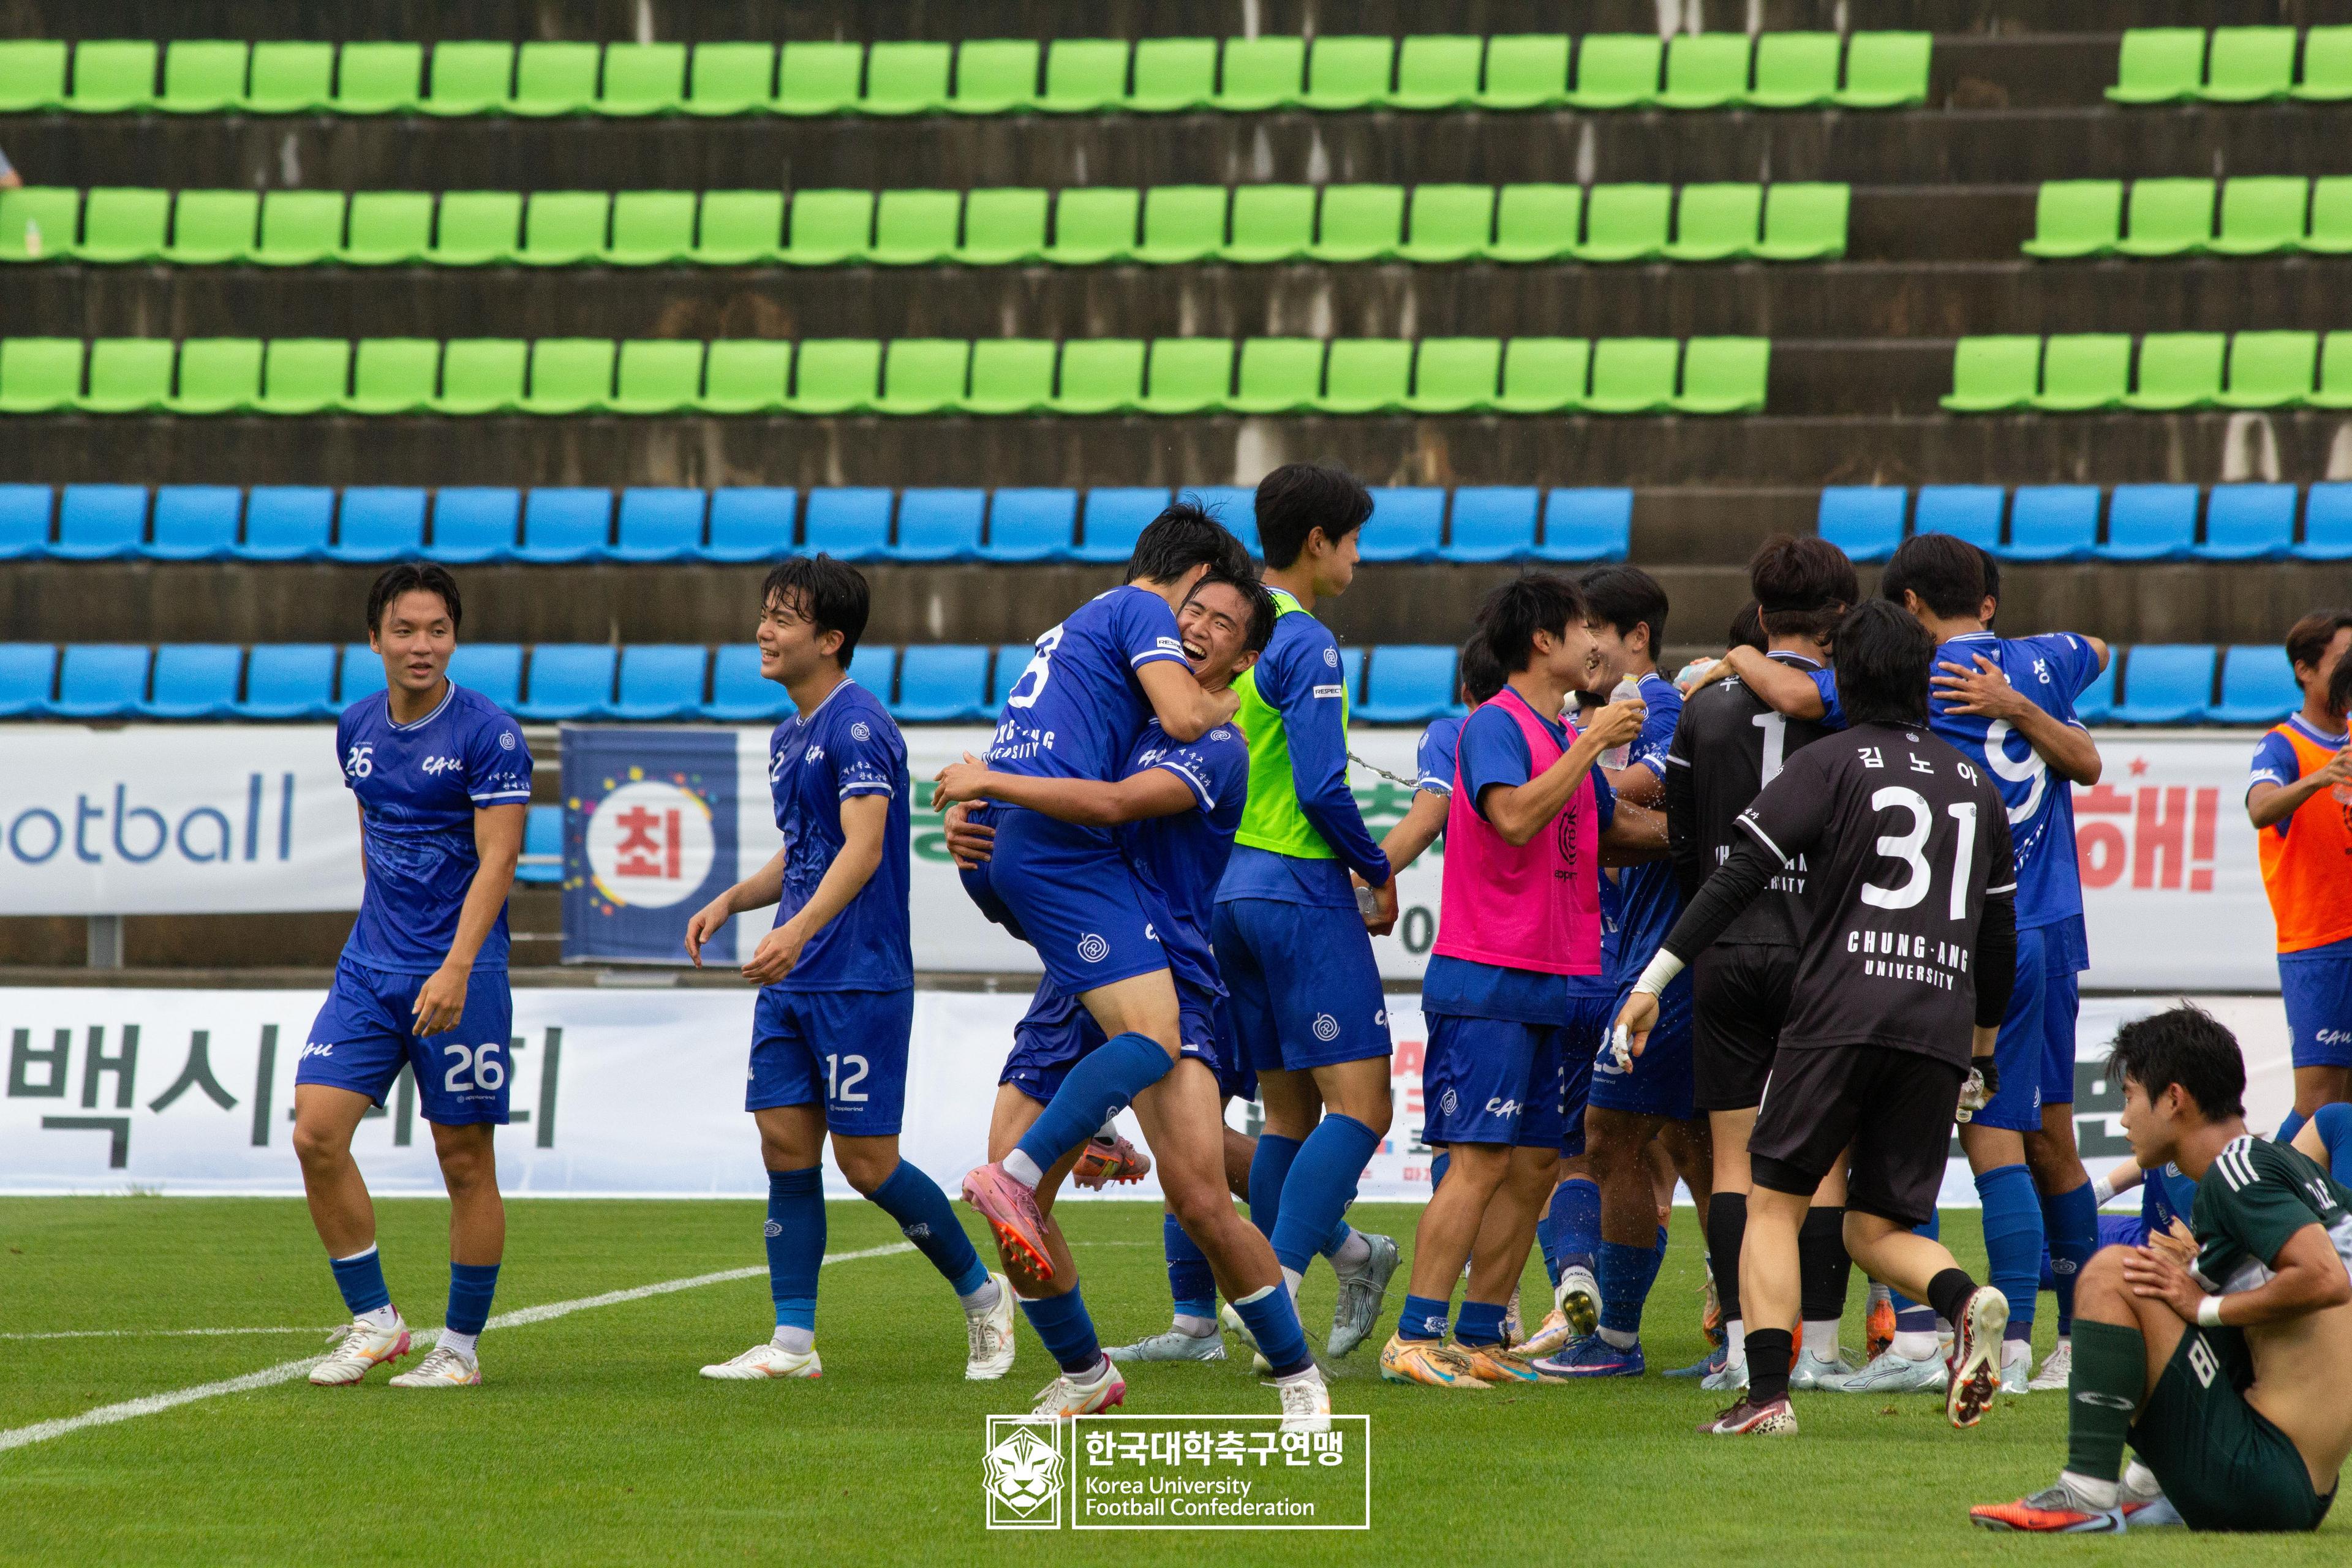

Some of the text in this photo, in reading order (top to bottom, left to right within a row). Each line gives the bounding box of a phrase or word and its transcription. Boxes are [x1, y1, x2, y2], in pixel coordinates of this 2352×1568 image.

[345, 747, 372, 777] 26
[1984, 718, 2046, 824] 9
[0, 772, 294, 863] otball
[617, 806, 680, 880] 최
[1861, 786, 1977, 920] 31
[1865, 960, 1954, 990] UNIVERSITY
[444, 1043, 504, 1091] 26
[826, 1054, 869, 1101] 12
